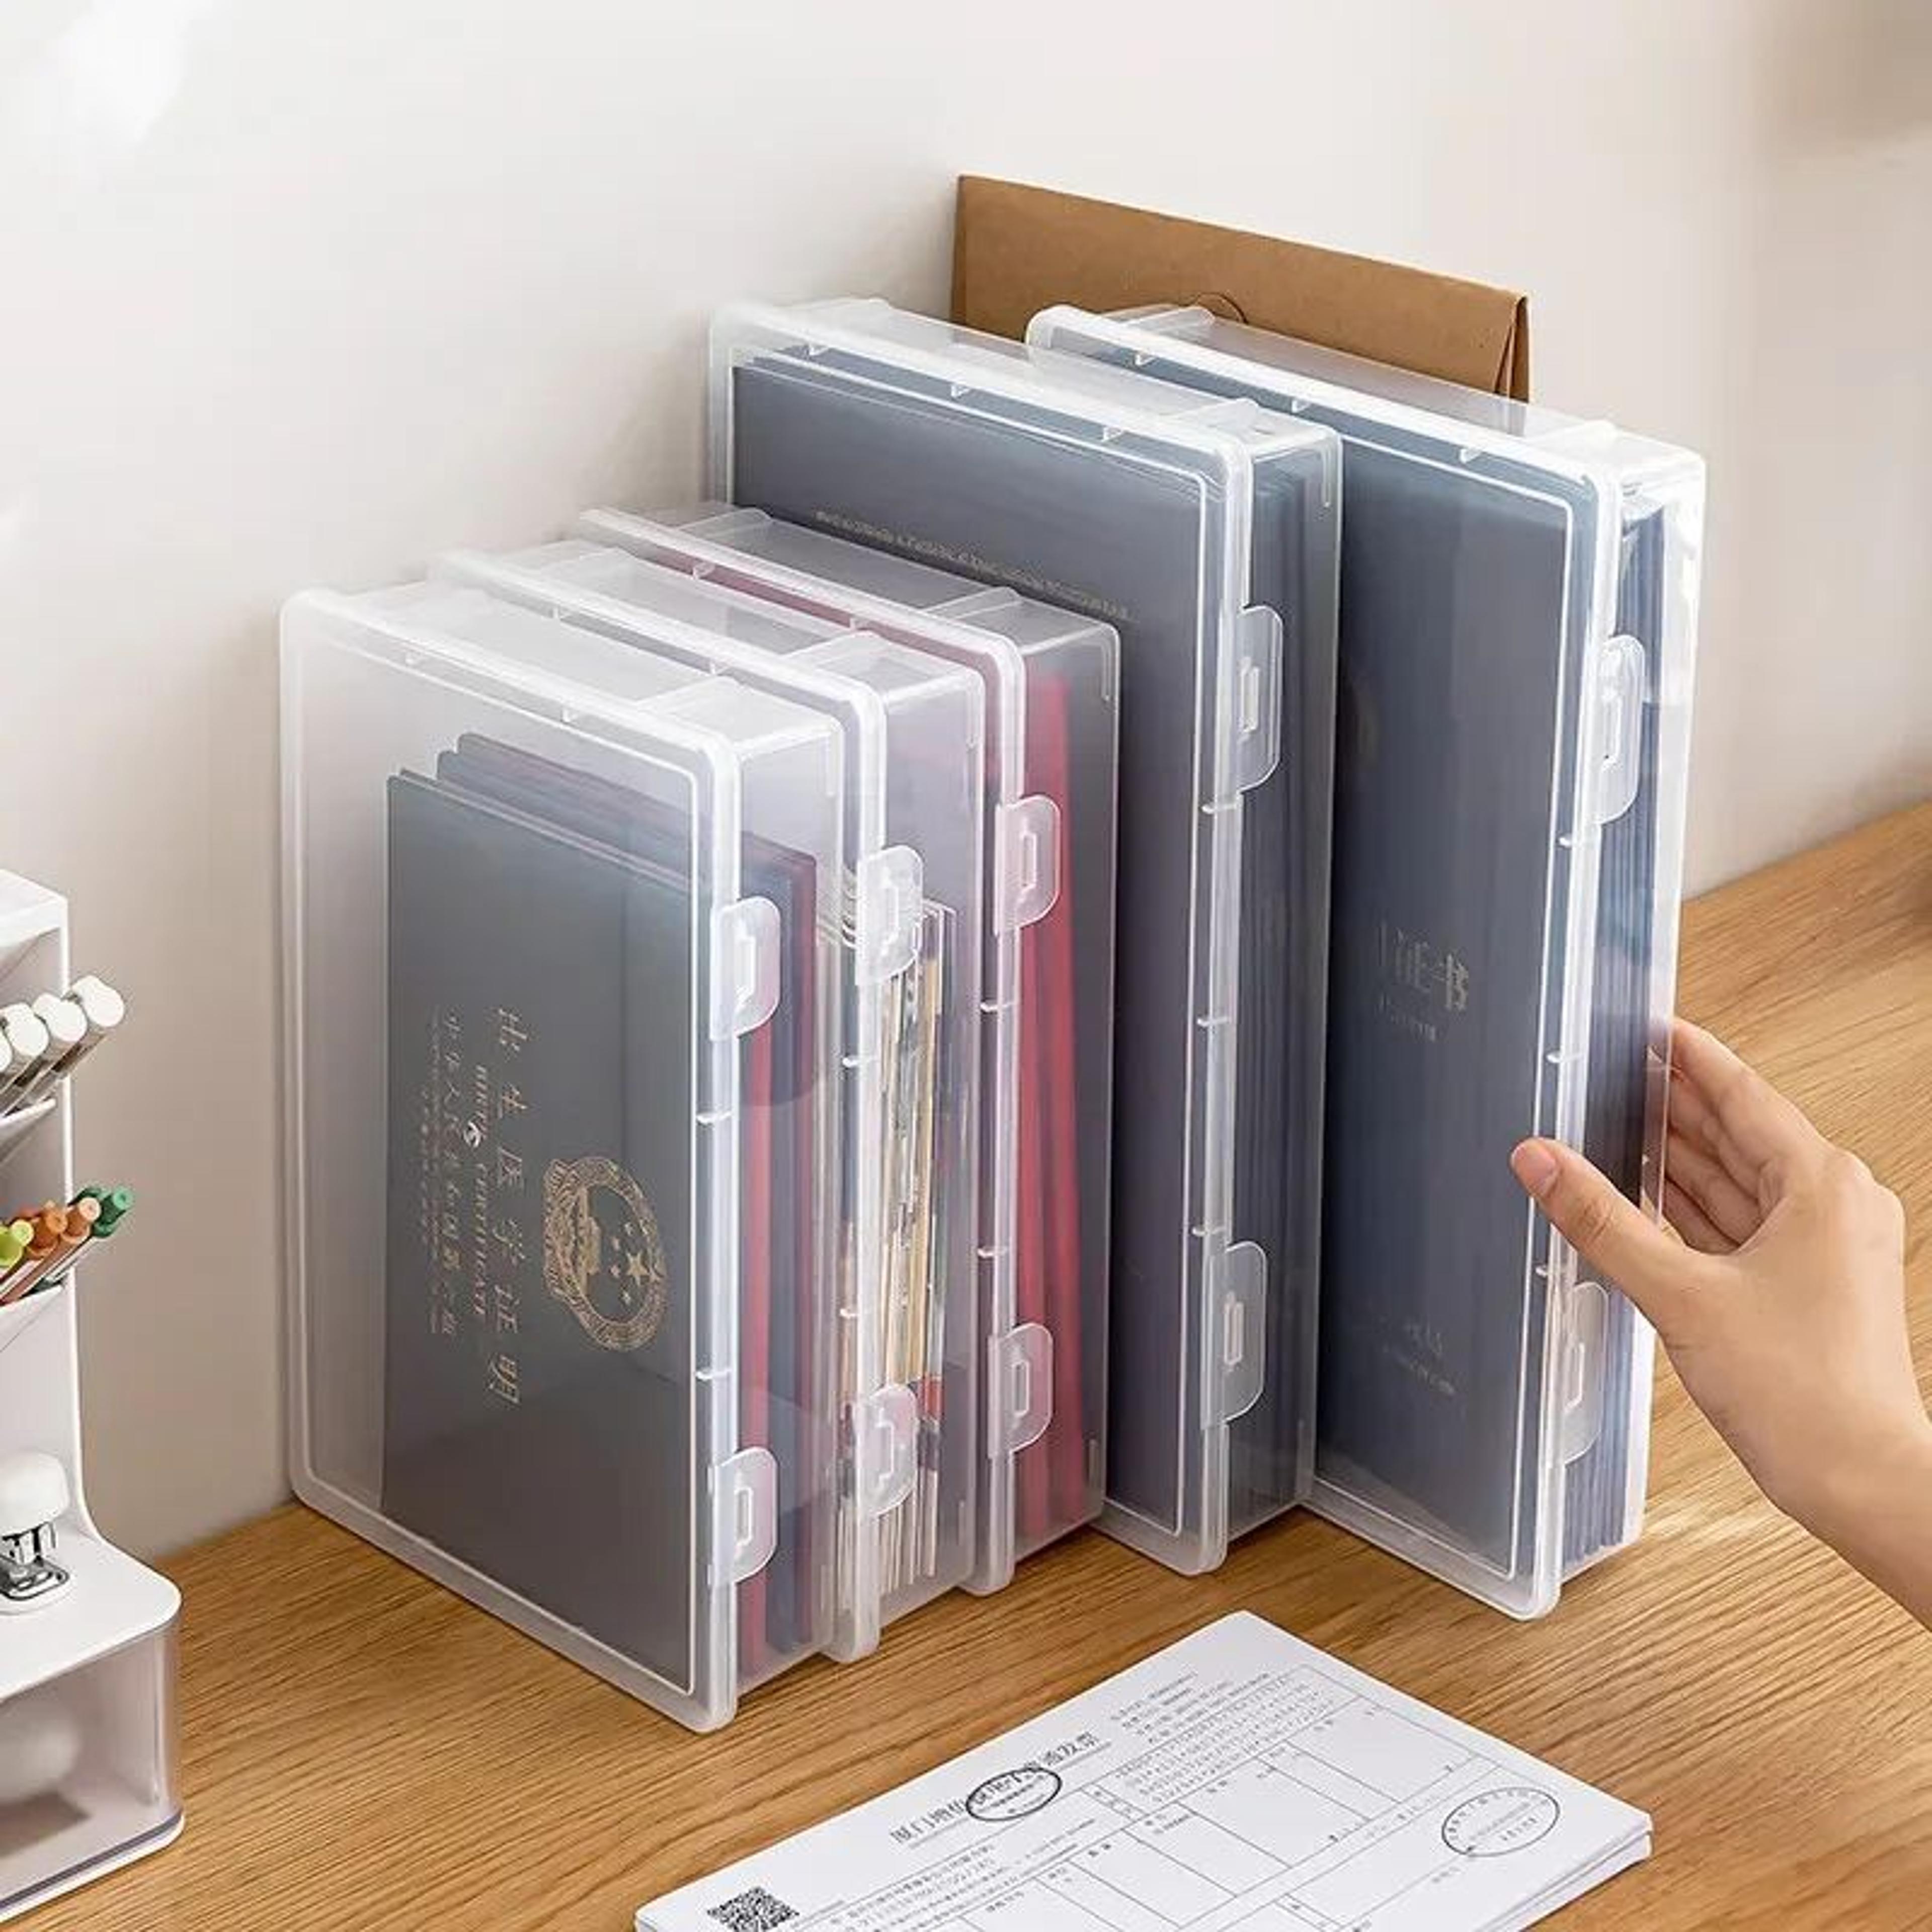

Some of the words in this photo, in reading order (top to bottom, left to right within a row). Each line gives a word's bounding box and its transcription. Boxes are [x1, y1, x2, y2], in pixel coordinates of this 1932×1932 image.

[487, 1007, 528, 1403] 出生医学证明
